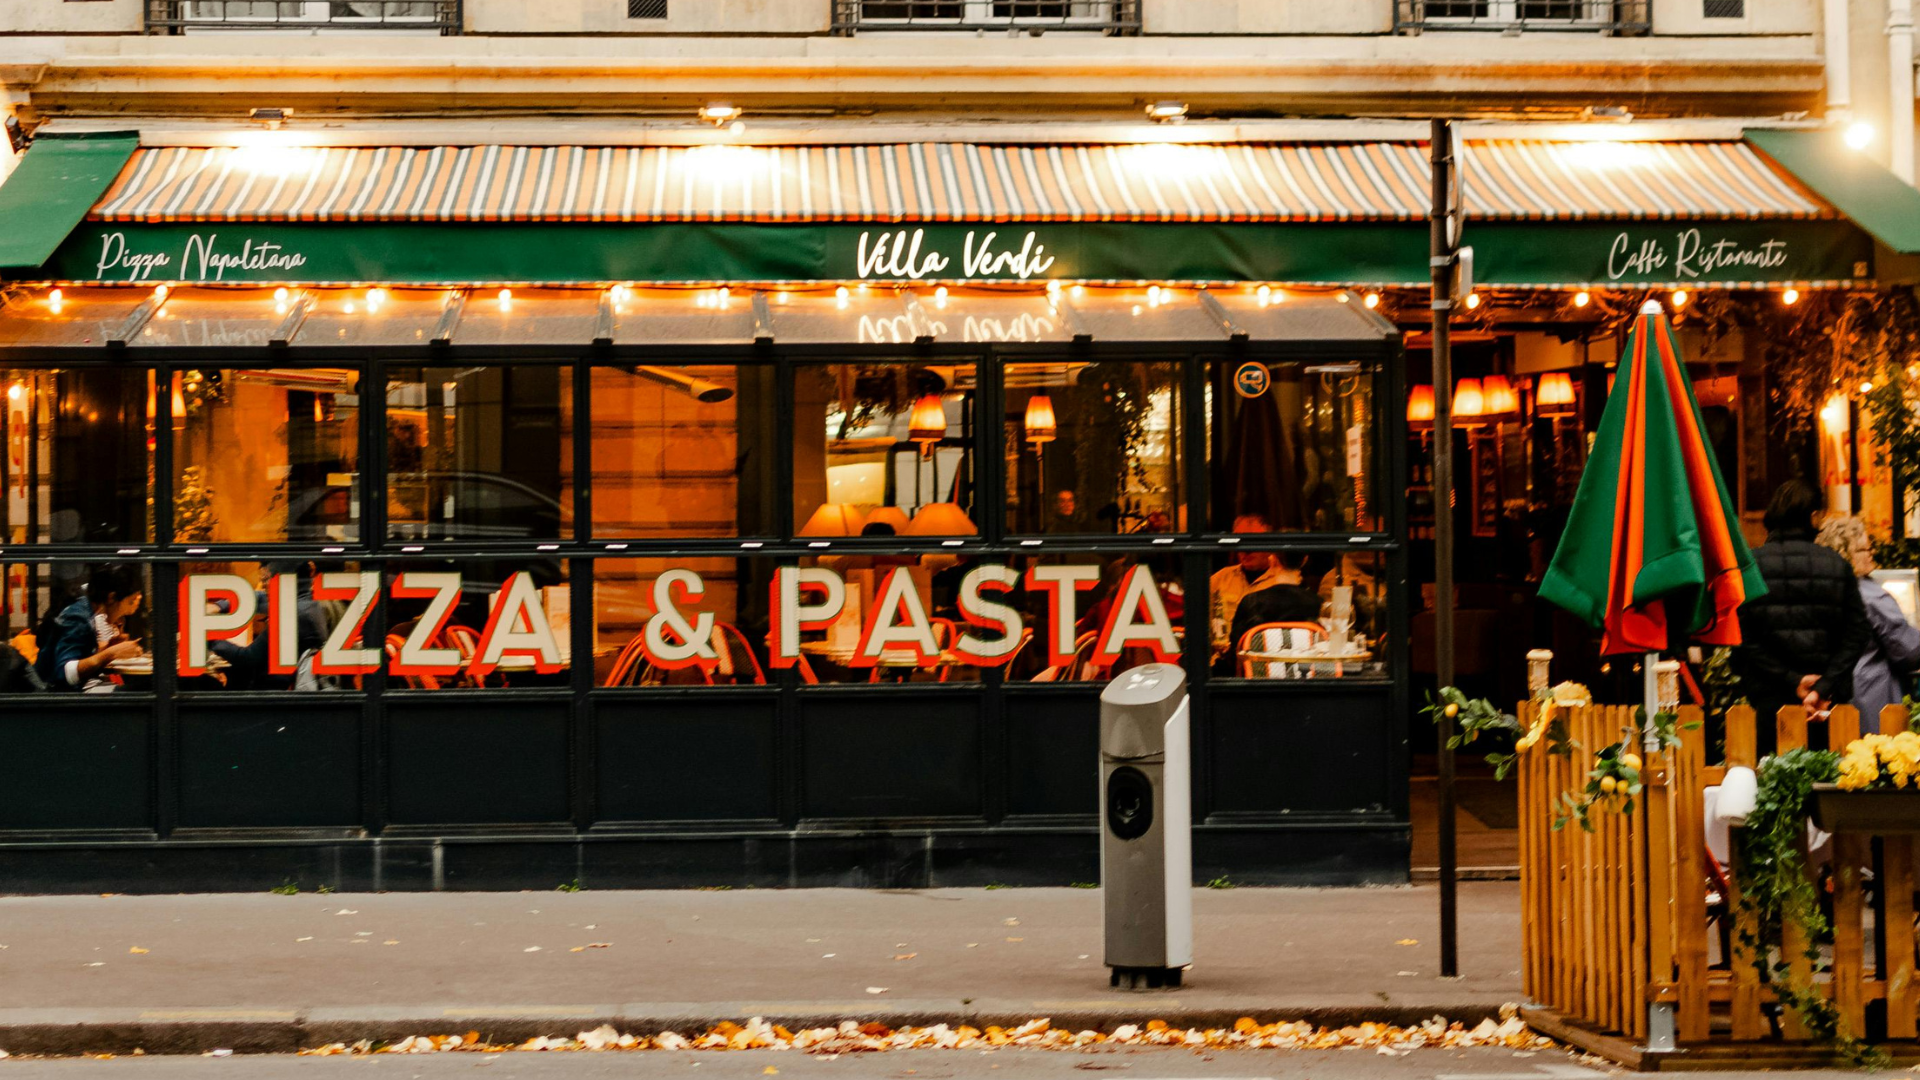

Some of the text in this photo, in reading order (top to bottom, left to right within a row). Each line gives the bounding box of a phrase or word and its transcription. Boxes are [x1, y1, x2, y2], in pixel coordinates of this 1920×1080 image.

[96, 232, 307, 282] Pizza Napoletana
[857, 228, 1055, 279] Villa Verdi
[1675, 227, 1788, 279] Ristorante
[178, 563, 1183, 677] PIZZA & PASTA
